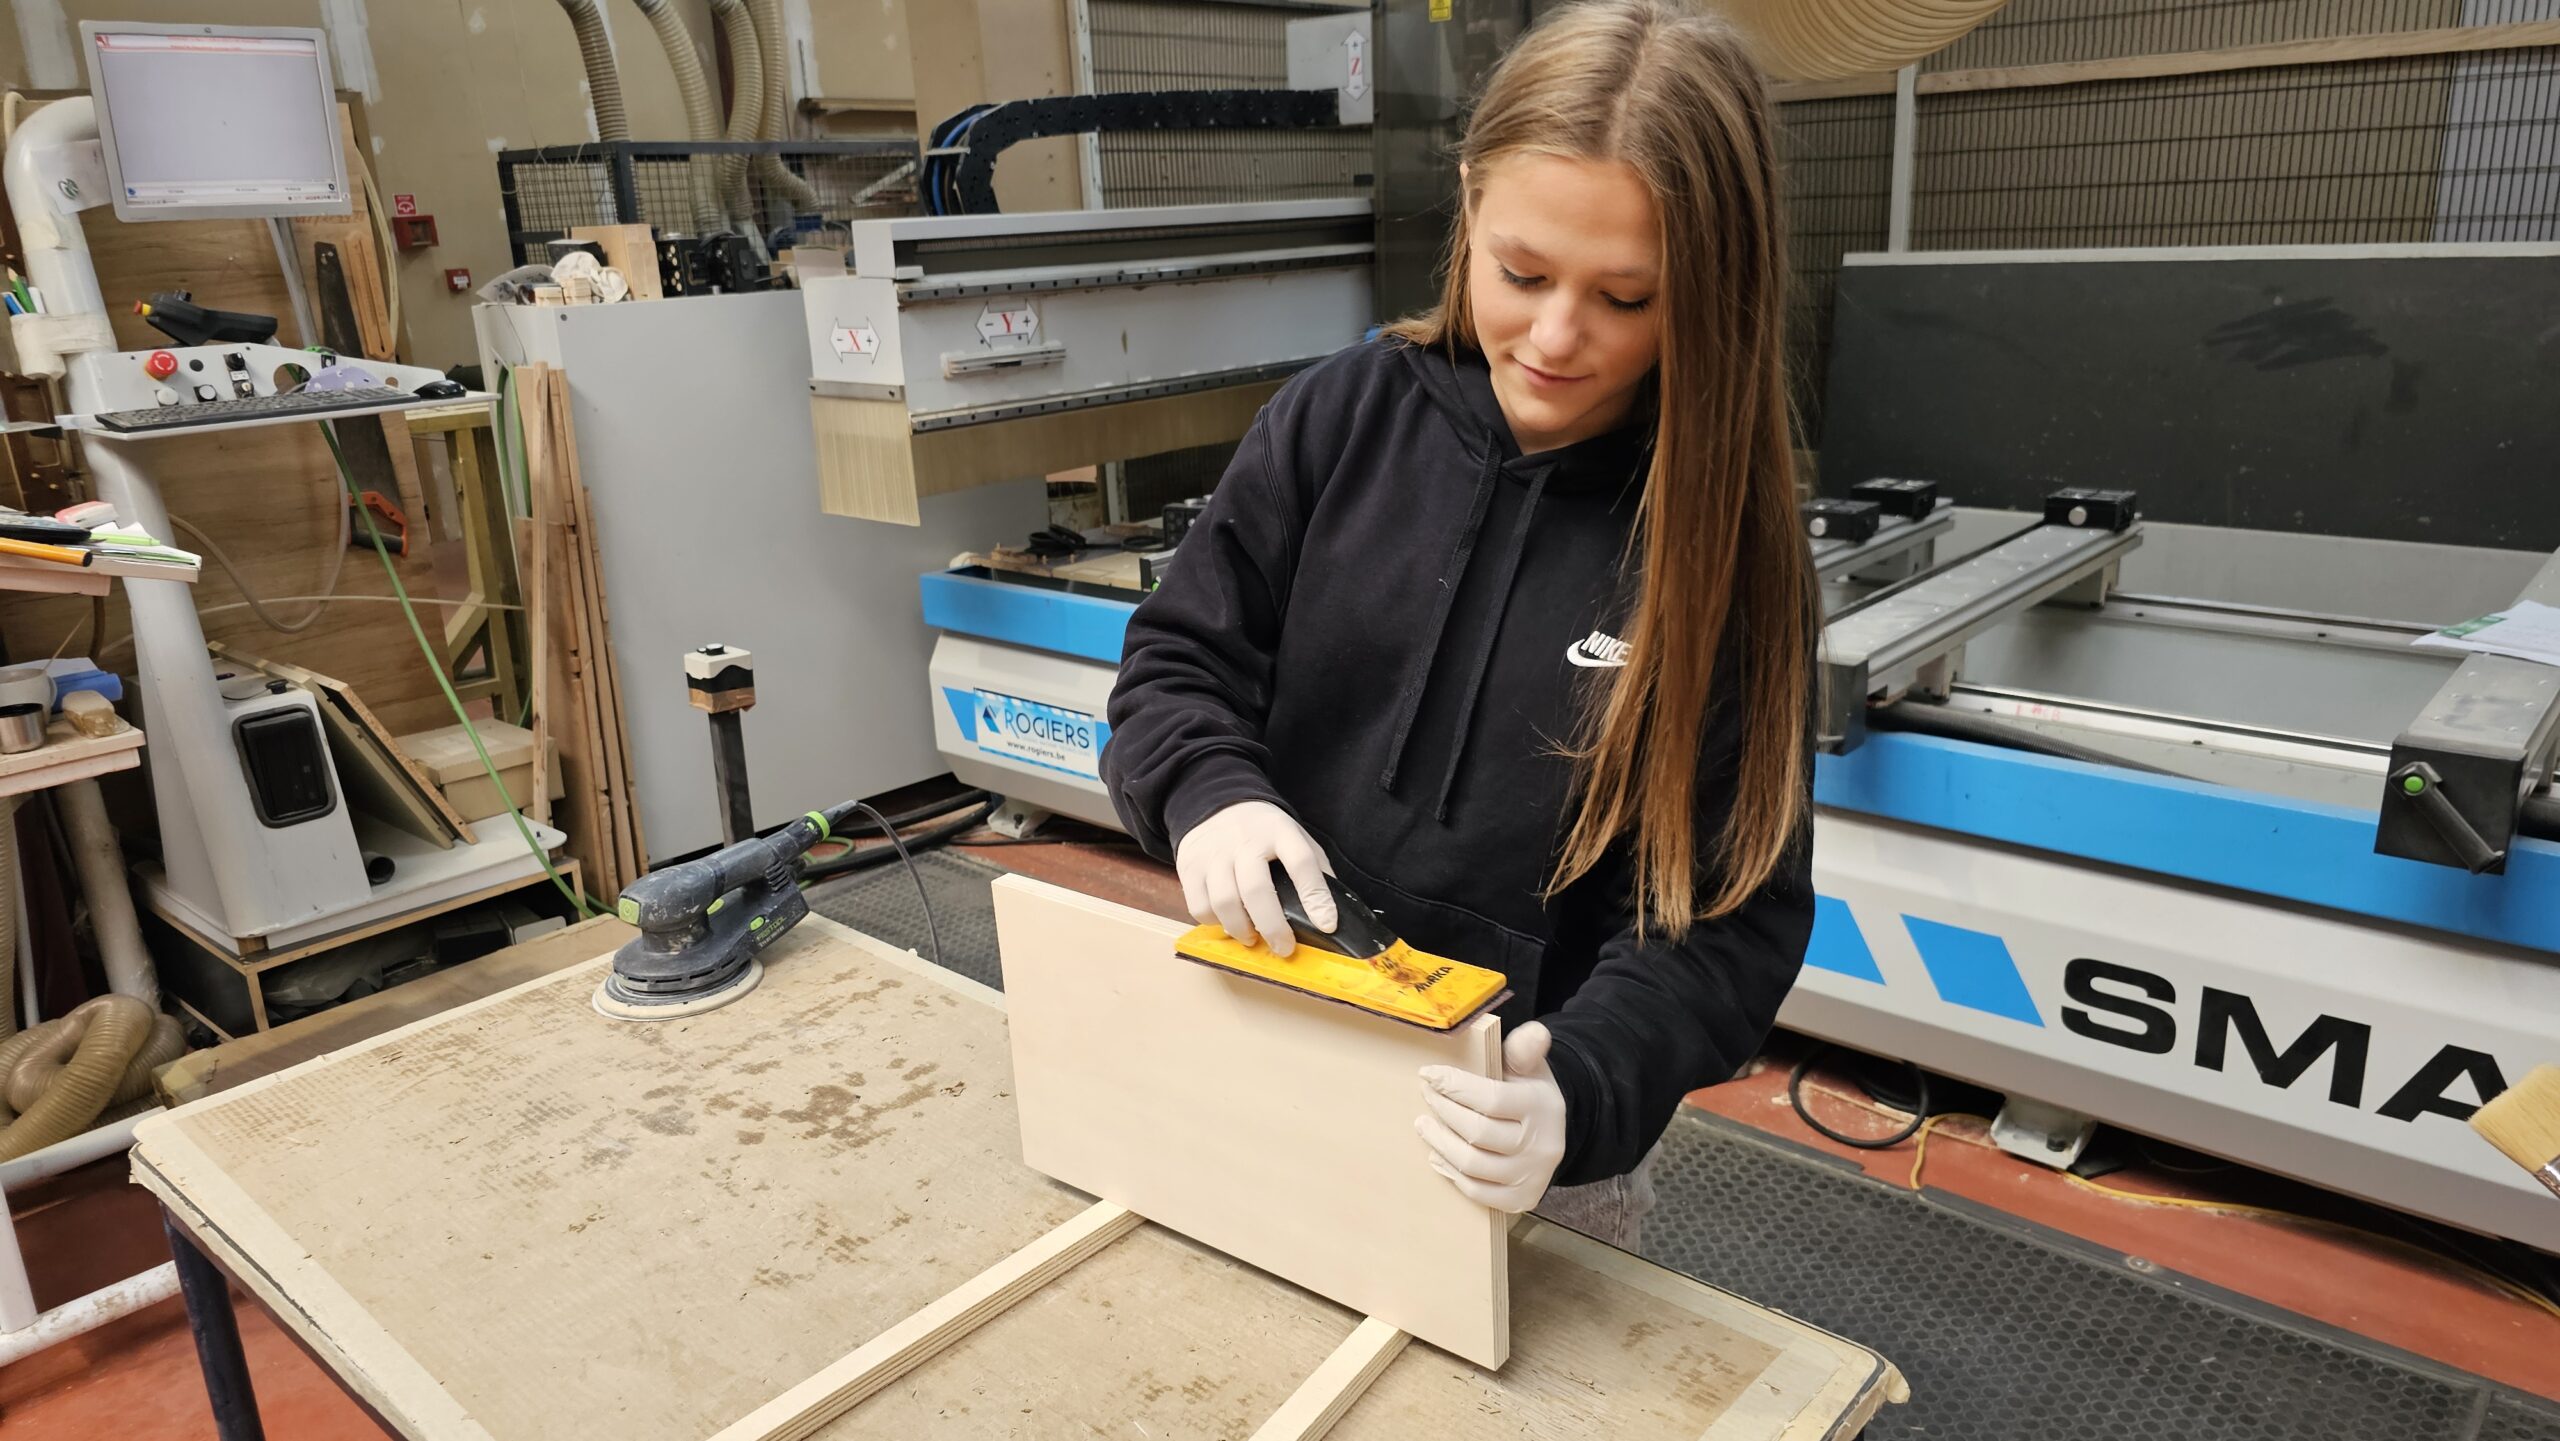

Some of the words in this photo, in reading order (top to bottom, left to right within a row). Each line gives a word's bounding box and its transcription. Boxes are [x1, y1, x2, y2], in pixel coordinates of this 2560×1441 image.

[1002, 311, 1016, 333] Y
[848, 330, 861, 351] X
[1580, 630, 1633, 662] NIKE
[1004, 708, 1090, 749] ROGIERS
[1007, 741, 1066, 761] www.rogiers.be
[1414, 966, 1454, 993] MIRKA
